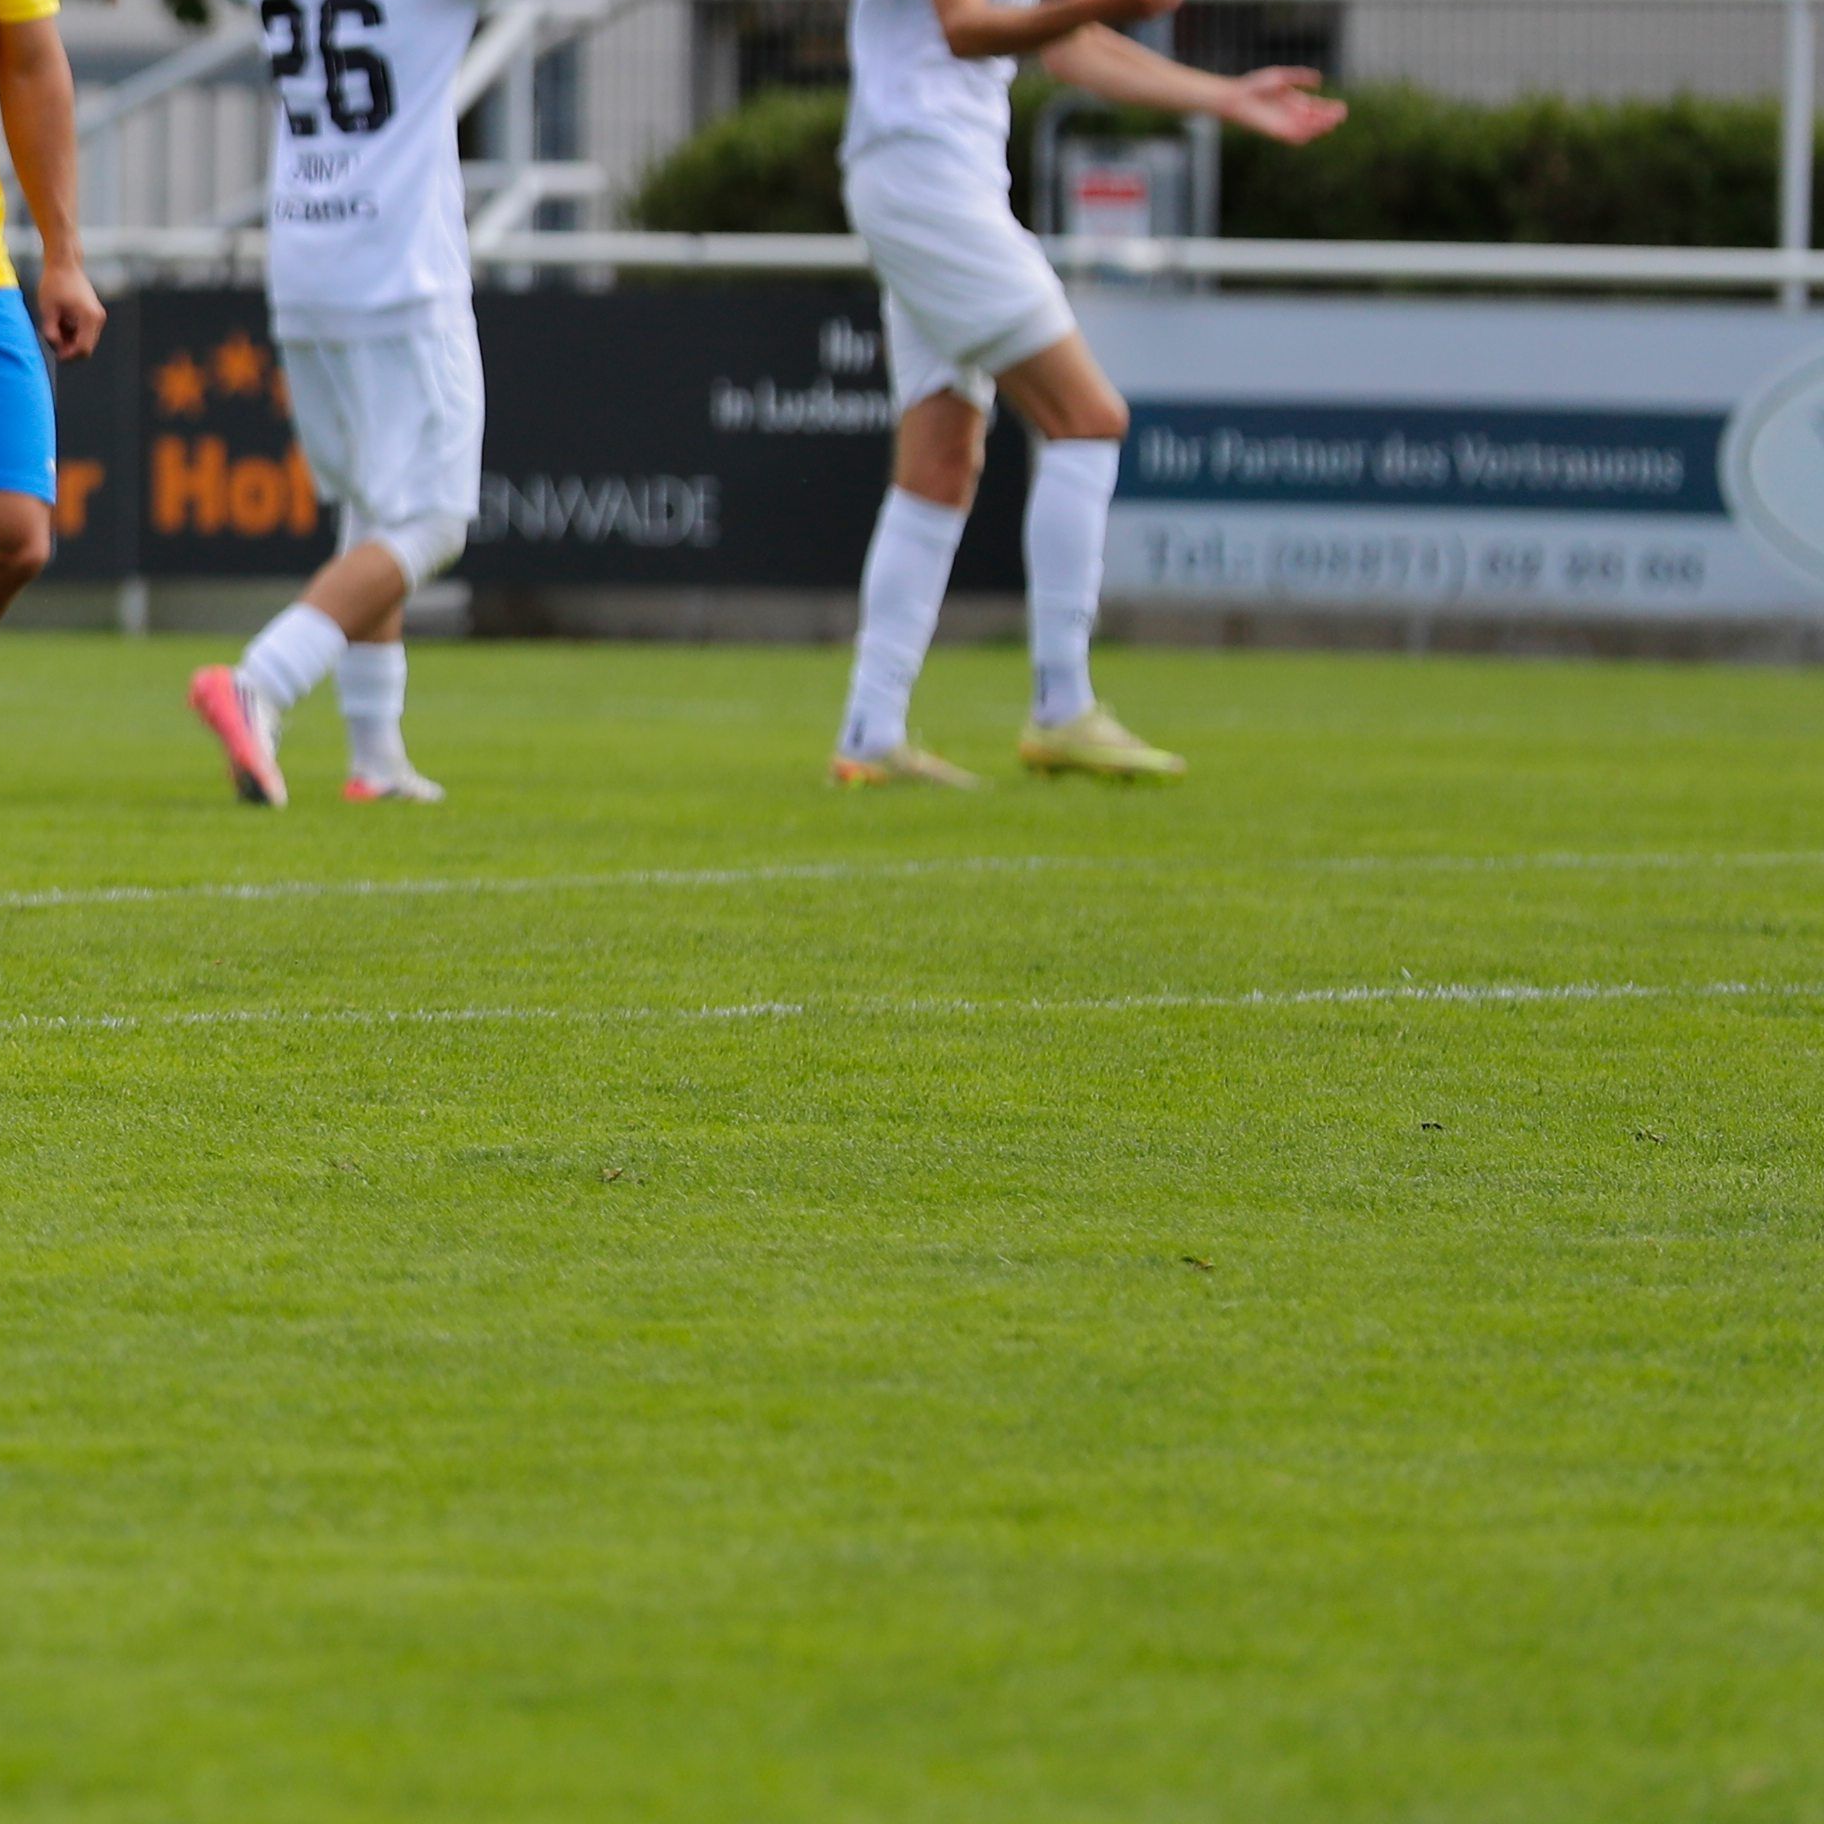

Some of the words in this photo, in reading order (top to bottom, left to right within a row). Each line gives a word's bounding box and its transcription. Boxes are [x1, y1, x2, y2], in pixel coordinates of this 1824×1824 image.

[754, 375, 895, 434] Lucken
[1139, 424, 1202, 483] Ihr
[1209, 426, 1366, 486] Partner
[1371, 428, 1451, 489] des
[1453, 431, 1686, 494] Vertrauens
